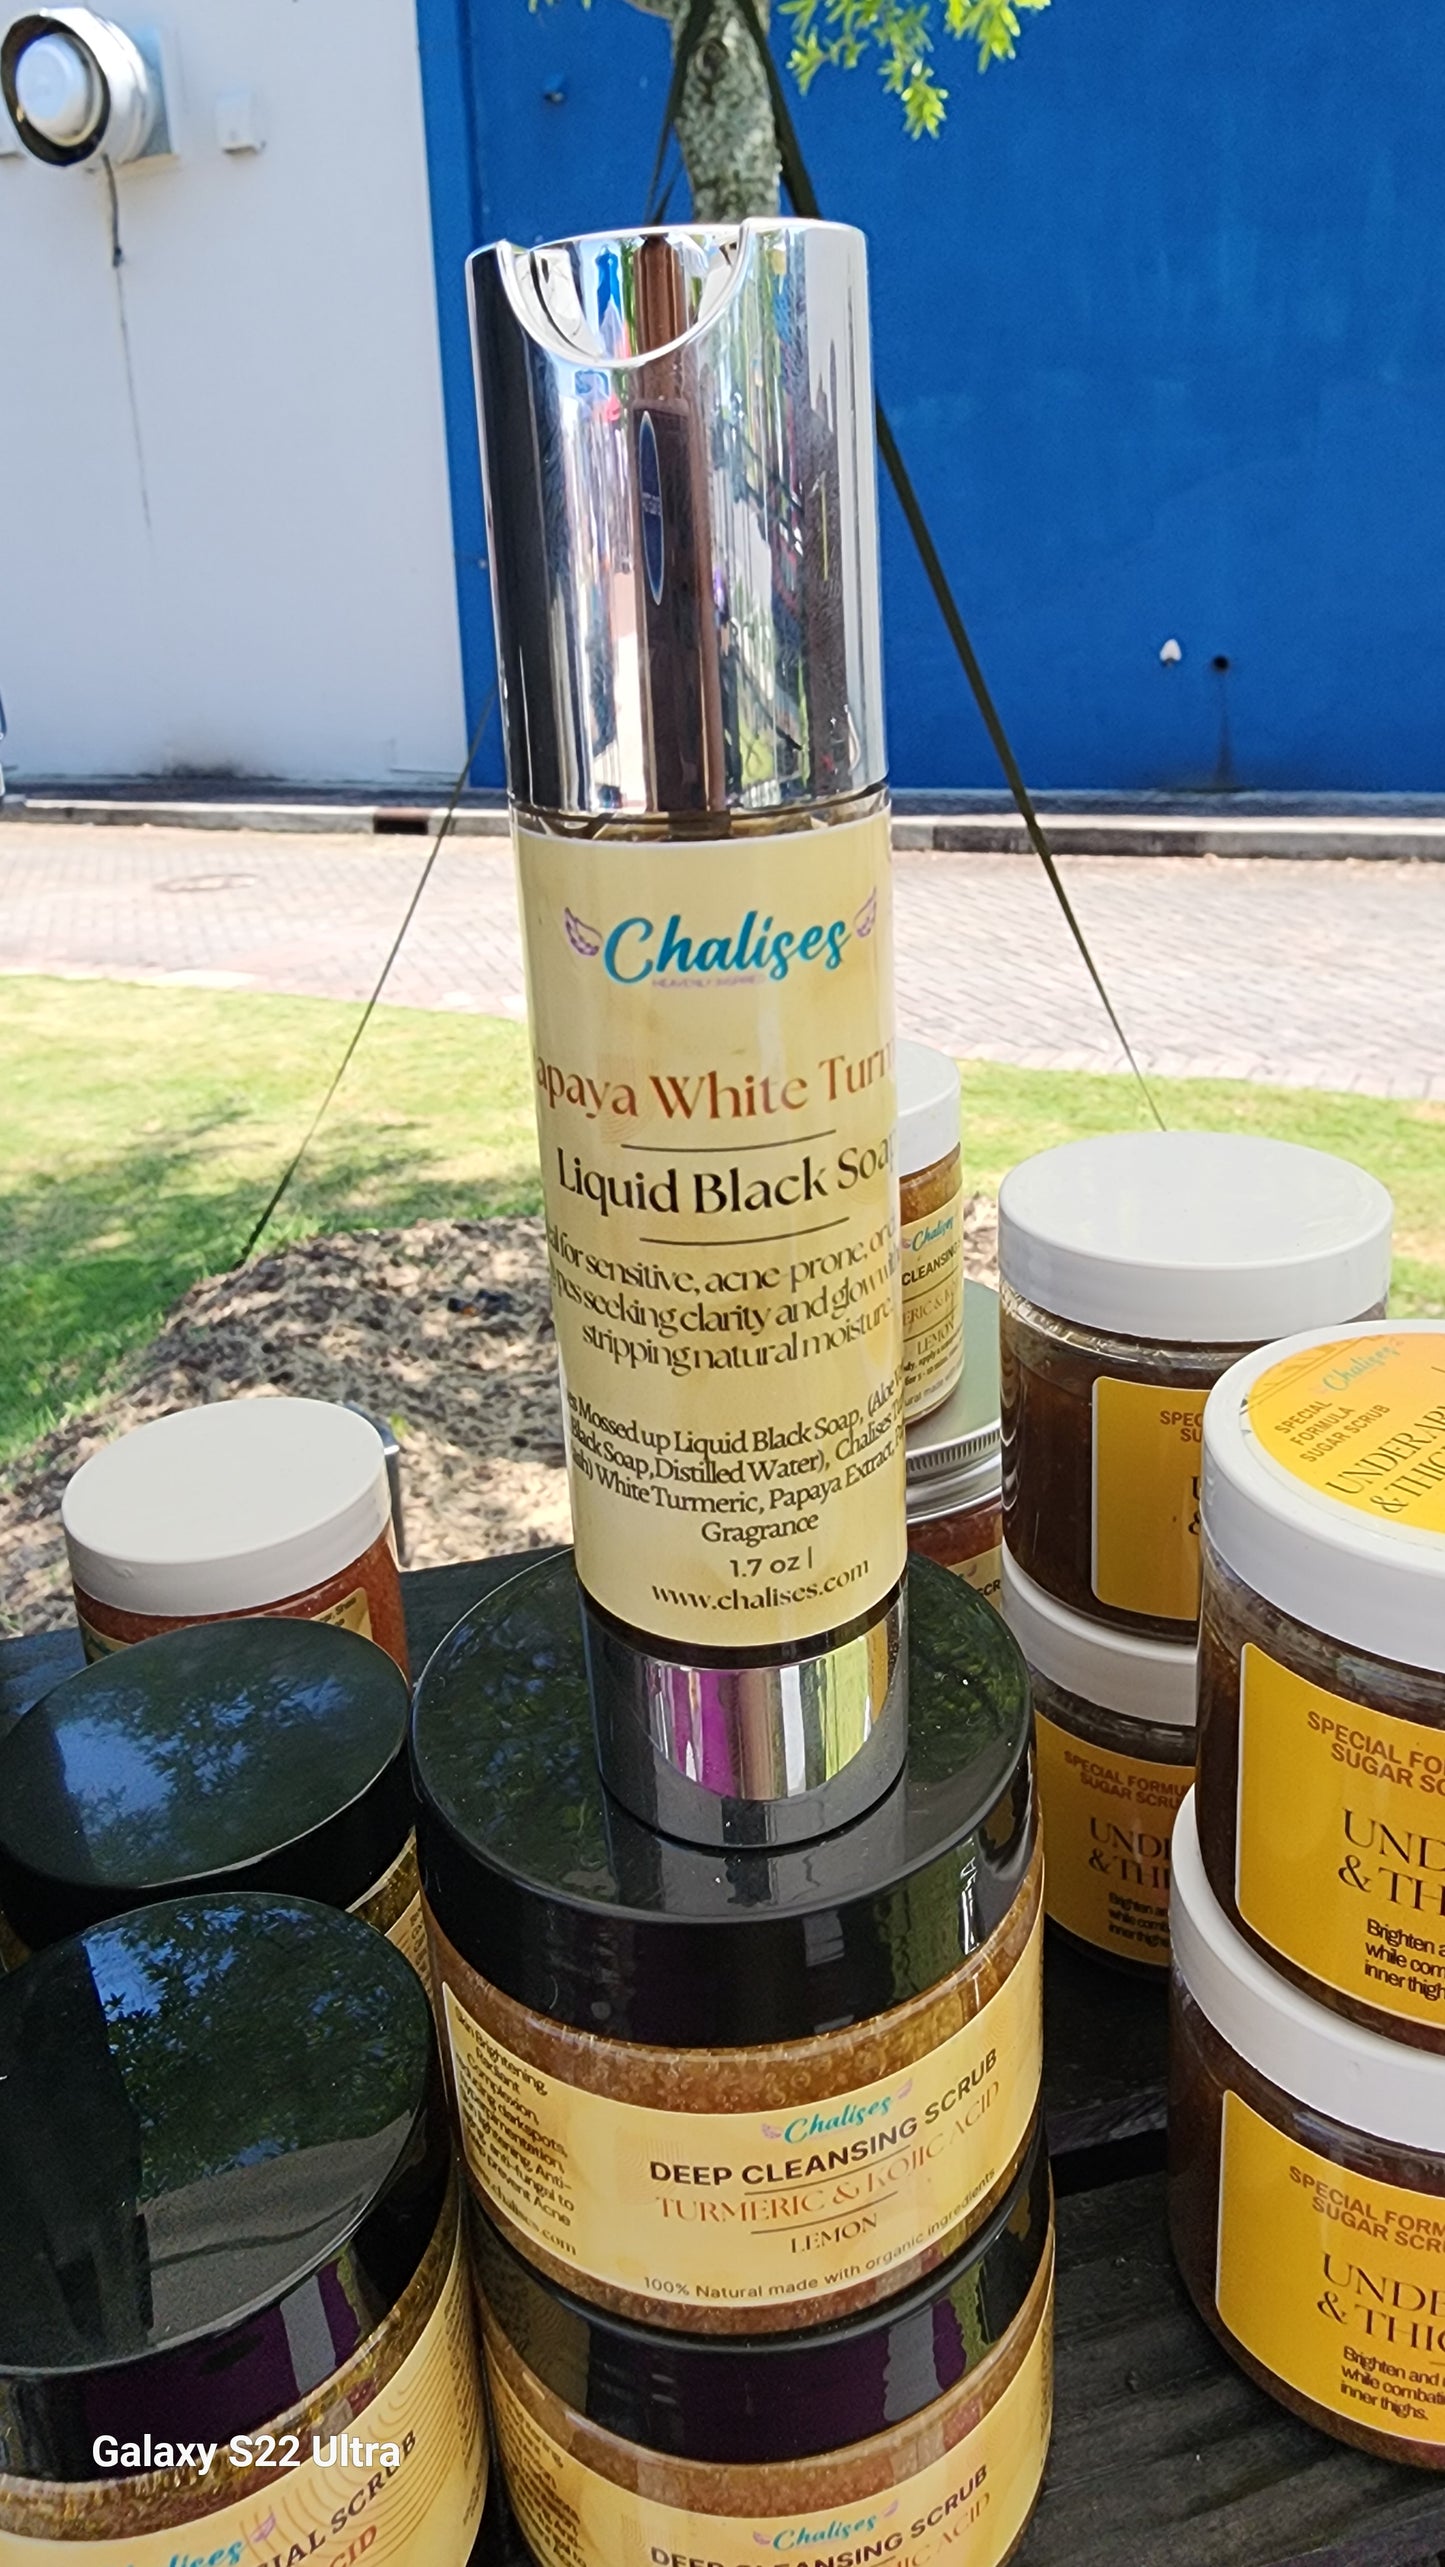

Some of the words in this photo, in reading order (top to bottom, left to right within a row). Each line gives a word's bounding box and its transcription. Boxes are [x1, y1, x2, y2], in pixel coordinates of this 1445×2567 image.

[604, 910, 851, 985] Chalises
[536, 1056, 638, 1119] apaya
[650, 1070, 808, 1119] White
[557, 1147, 680, 1217] Liquid
[694, 1156, 829, 1214] Black
[560, 1232, 584, 1268] for
[586, 1253, 700, 1296] sensitive,
[705, 1267, 781, 1293] acne
[790, 1241, 868, 1293] prone,
[556, 1268, 583, 1304] pes
[583, 1290, 679, 1338] seeking
[680, 1301, 771, 1336] clarity
[775, 1284, 828, 1327] and
[582, 1325, 692, 1377] stripping
[695, 1331, 798, 1369] natural
[578, 1395, 638, 1444] Mossed
[642, 1429, 671, 1455] up
[674, 1429, 749, 1461] Liquid
[752, 1421, 812, 1453] Black
[814, 1407, 864, 1441] Soap,
[1274, 1400, 1333, 1434] SPECIAL
[1290, 1406, 1355, 1446] FORMULA
[1300, 1431, 1352, 1462] SUGAR
[1347, 1404, 1390, 1434] SCRUB
[747, 1448, 830, 1483] Water),
[1325, 1432, 1433, 1495] UNDER
[594, 1462, 651, 1503] White
[651, 1484, 766, 1515] Turmeric,
[769, 1476, 843, 1511] Papaya
[1370, 1494, 1409, 1513] &
[651, 1559, 870, 1611] www.chalises.com
[729, 1557, 763, 1578] 1.7
[769, 1554, 800, 1575] oz
[1307, 1710, 1402, 1764] SPECIAL
[1409, 1750, 1445, 1775] FO
[1064, 1750, 1124, 1784] SPECIAL
[1080, 1771, 1132, 1801] SUGAR
[1331, 1742, 1413, 1788] SUGAR
[1088, 1847, 1110, 1874] &
[1338, 1854, 1372, 1893] &
[1365, 1941, 1407, 1968] while
[1367, 1917, 1435, 1954] Brighten
[1364, 1958, 1406, 1988] inner
[649, 2161, 733, 2186] DEEP
[741, 2116, 918, 2185] CLEANSING
[924, 2048, 998, 2125] SCRUB
[783, 2094, 895, 2145] Chalises
[655, 2190, 827, 2223] TURMERIC
[831, 2179, 862, 2206] &
[948, 2080, 1001, 2145] ACID
[533, 2196, 571, 2226] Acne
[557, 2194, 575, 2212] to
[1289, 2164, 1378, 2221] SPECIAL
[644, 2276, 690, 2297] 100%
[695, 2283, 763, 2298] Natural
[768, 2276, 818, 2297] made
[824, 2258, 861, 2285] with
[866, 2234, 924, 2271] organic
[927, 2169, 996, 2238] ingredients
[790, 2213, 878, 2254] LEMON
[1311, 2195, 1389, 2242] SUGAR
[1394, 2230, 1445, 2254] SCR
[1316, 2290, 1348, 2325] &
[1341, 2365, 1380, 2390] while
[1343, 2345, 1406, 2379] Brighten
[1408, 2370, 1440, 2387] and
[1340, 2380, 1379, 2406] inner
[650, 2547, 726, 2567] DE
[737, 2532, 903, 2567] NSING
[911, 2464, 988, 2539] SCRUB
[772, 2514, 878, 2551] Chalises
[254, 2529, 326, 2567] IAL
[328, 2524, 378, 2567] CID
